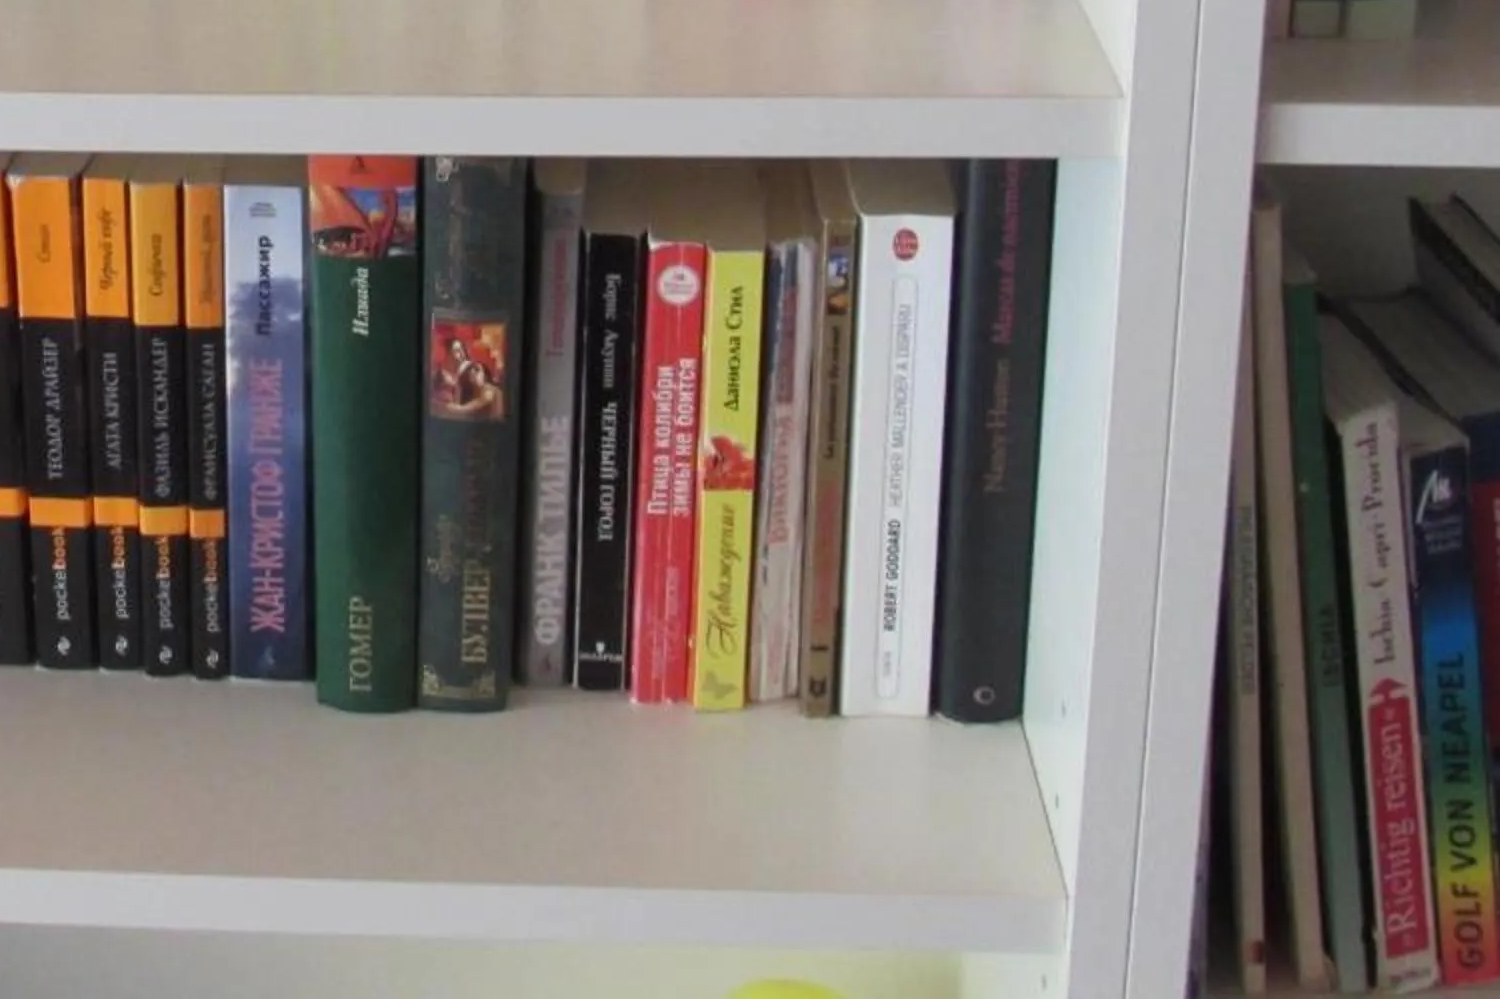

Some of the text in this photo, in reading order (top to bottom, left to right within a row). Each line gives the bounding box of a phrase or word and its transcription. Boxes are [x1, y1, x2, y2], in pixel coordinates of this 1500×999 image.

[350, 266, 371, 336] Илиада
[893, 358, 908, 371] A
[894, 303, 912, 357] DISPARU
[42, 336, 64, 480] ТЕОДОР ДРАЙЗЕР
[102, 351, 123, 470] АГАТА КРИСТИ
[151, 336, 172, 498] ФАЗИЛЬ ИСКАНДЕР
[248, 234, 286, 633] ЖАН-КРИСТОФ ГРАНЖЕ Пассажир
[596, 272, 622, 542] Борис Акунин ЧЕРНЫЙ ГОРОД
[647, 365, 675, 515] Птица колибри
[672, 357, 697, 517] зимы не боится
[707, 284, 745, 659] Наваждение Даниэла Стил
[891, 373, 910, 449] MALLENDER
[533, 414, 570, 645] ФРАНК ТИЛЬЕ
[888, 451, 905, 507] HEATHER
[885, 519, 903, 581] GODDARD
[885, 585, 901, 632] ROBERT
[348, 595, 374, 694] ГОМЕР
[1433, 650, 1486, 971] GOLF VON NEAPEL
